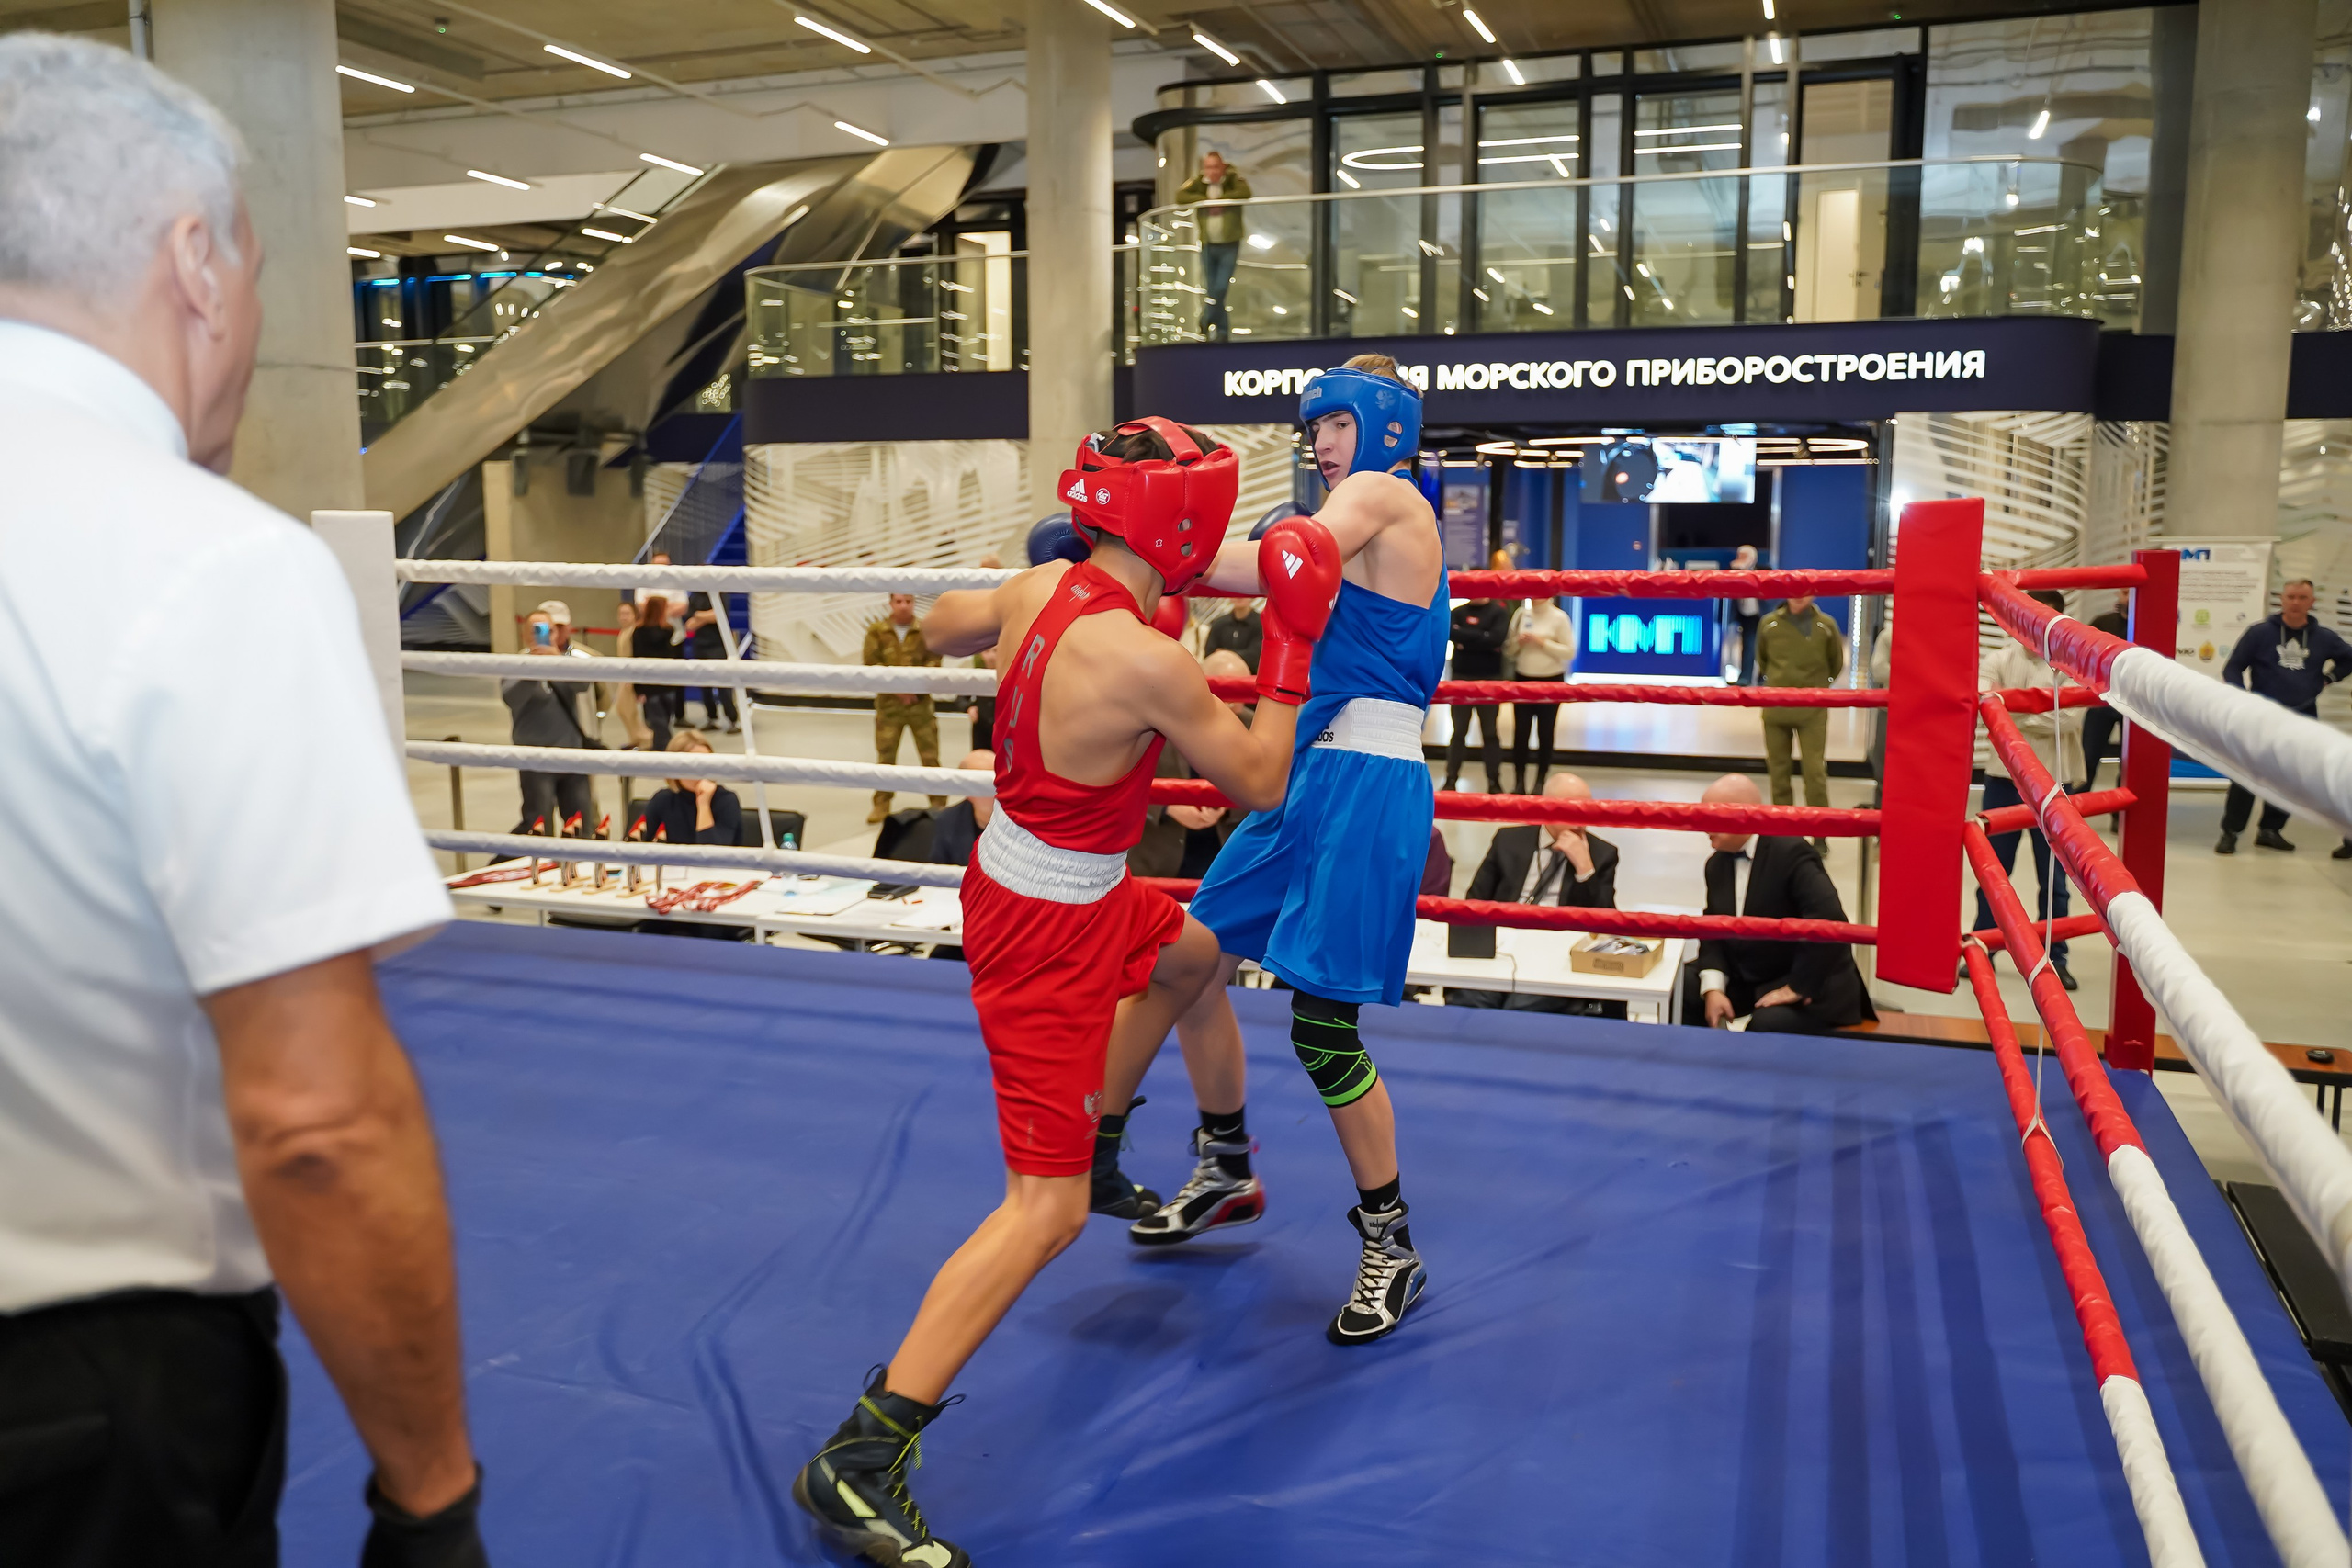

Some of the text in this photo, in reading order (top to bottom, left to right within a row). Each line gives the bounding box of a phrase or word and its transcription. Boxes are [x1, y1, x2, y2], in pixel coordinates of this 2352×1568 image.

[1436, 360, 1617, 390] МОРСКОГО
[1626, 350, 1986, 387] ПРИБОРОСТРОЕНИЯ
[1589, 613, 1703, 655] КМП
